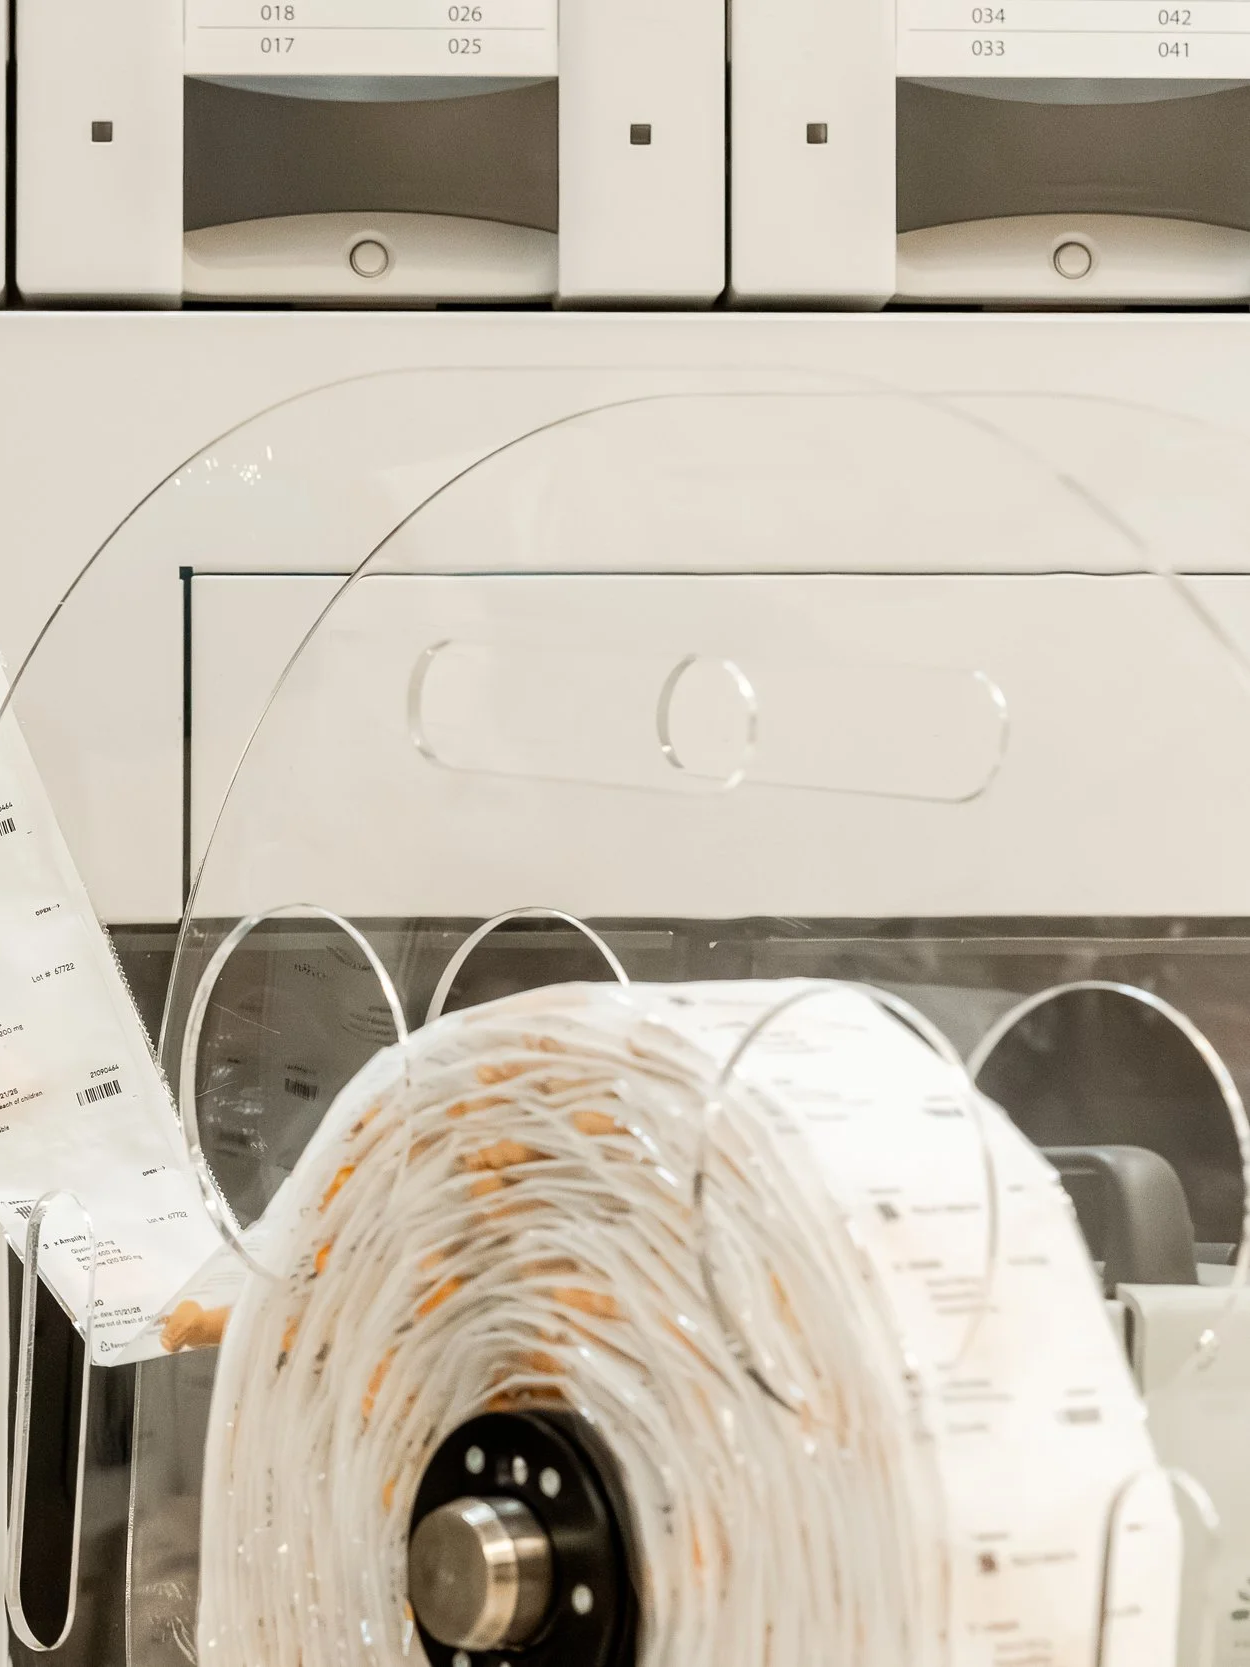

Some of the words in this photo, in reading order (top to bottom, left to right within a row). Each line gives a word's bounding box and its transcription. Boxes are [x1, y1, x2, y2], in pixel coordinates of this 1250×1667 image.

[261, 5, 295, 22] 018
[448, 6, 482, 22] 026
[972, 8, 1006, 24] 034
[1158, 10, 1192, 26] 042
[261, 37, 295, 54] 017
[448, 39, 482, 55] 025
[972, 40, 1005, 56] 033
[1158, 42, 1191, 58] 041
[35, 906, 52, 917] OPEN
[31, 974, 44, 984] Lot
[54, 962, 76, 976] 67722
[13, 1024, 24, 1032] mg
[90, 1064, 119, 1079] 21090464
[14, 1097, 21, 1106] of
[59, 1234, 88, 1246] Amplify
